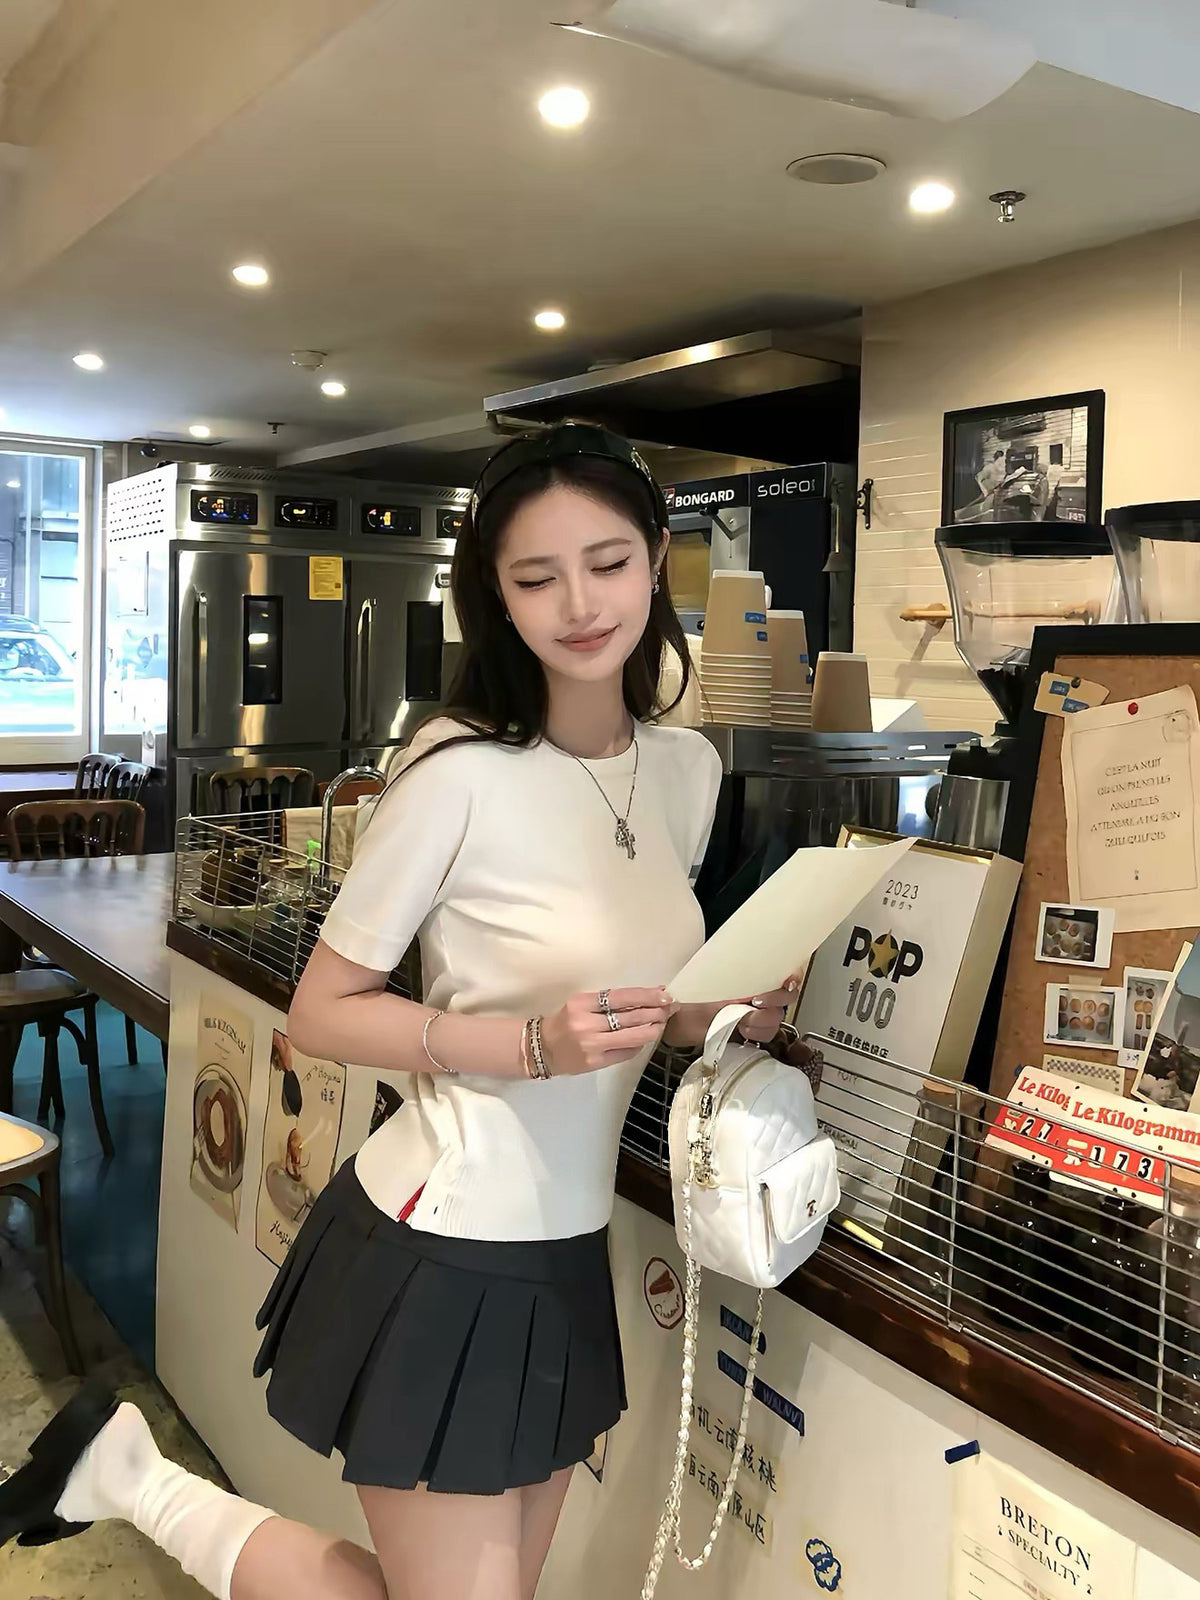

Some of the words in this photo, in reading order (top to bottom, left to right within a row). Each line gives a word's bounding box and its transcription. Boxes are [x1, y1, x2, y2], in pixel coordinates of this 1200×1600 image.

[675, 489, 735, 507] BONGARD
[757, 478, 811, 498] soleo
[885, 879, 919, 900] 2023
[842, 925, 924, 984] POP
[846, 977, 896, 1030] 100
[1017, 1077, 1036, 1094] Le
[1072, 1101, 1095, 1120] Le
[690, 1396, 777, 1493] 机云南核桃
[1000, 1496, 1091, 1571] BRETON
[1008, 1529, 1081, 1586] SPECIALTY
